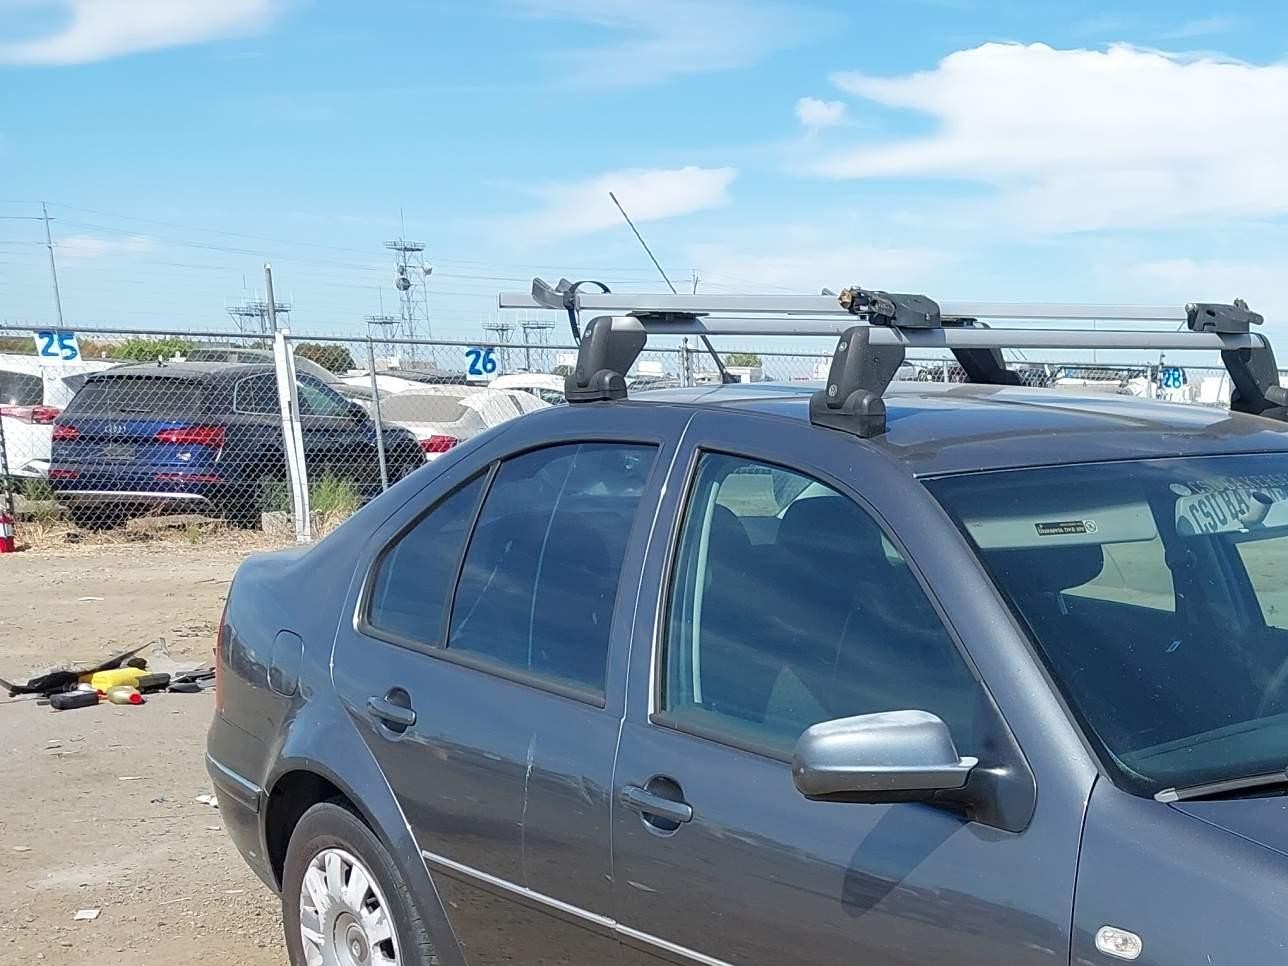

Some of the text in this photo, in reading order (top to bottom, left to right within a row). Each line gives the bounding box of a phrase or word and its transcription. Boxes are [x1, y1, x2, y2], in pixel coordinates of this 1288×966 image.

[39, 331, 78, 361] 25
[467, 347, 497, 375] 26
[1162, 367, 1183, 389] 28
